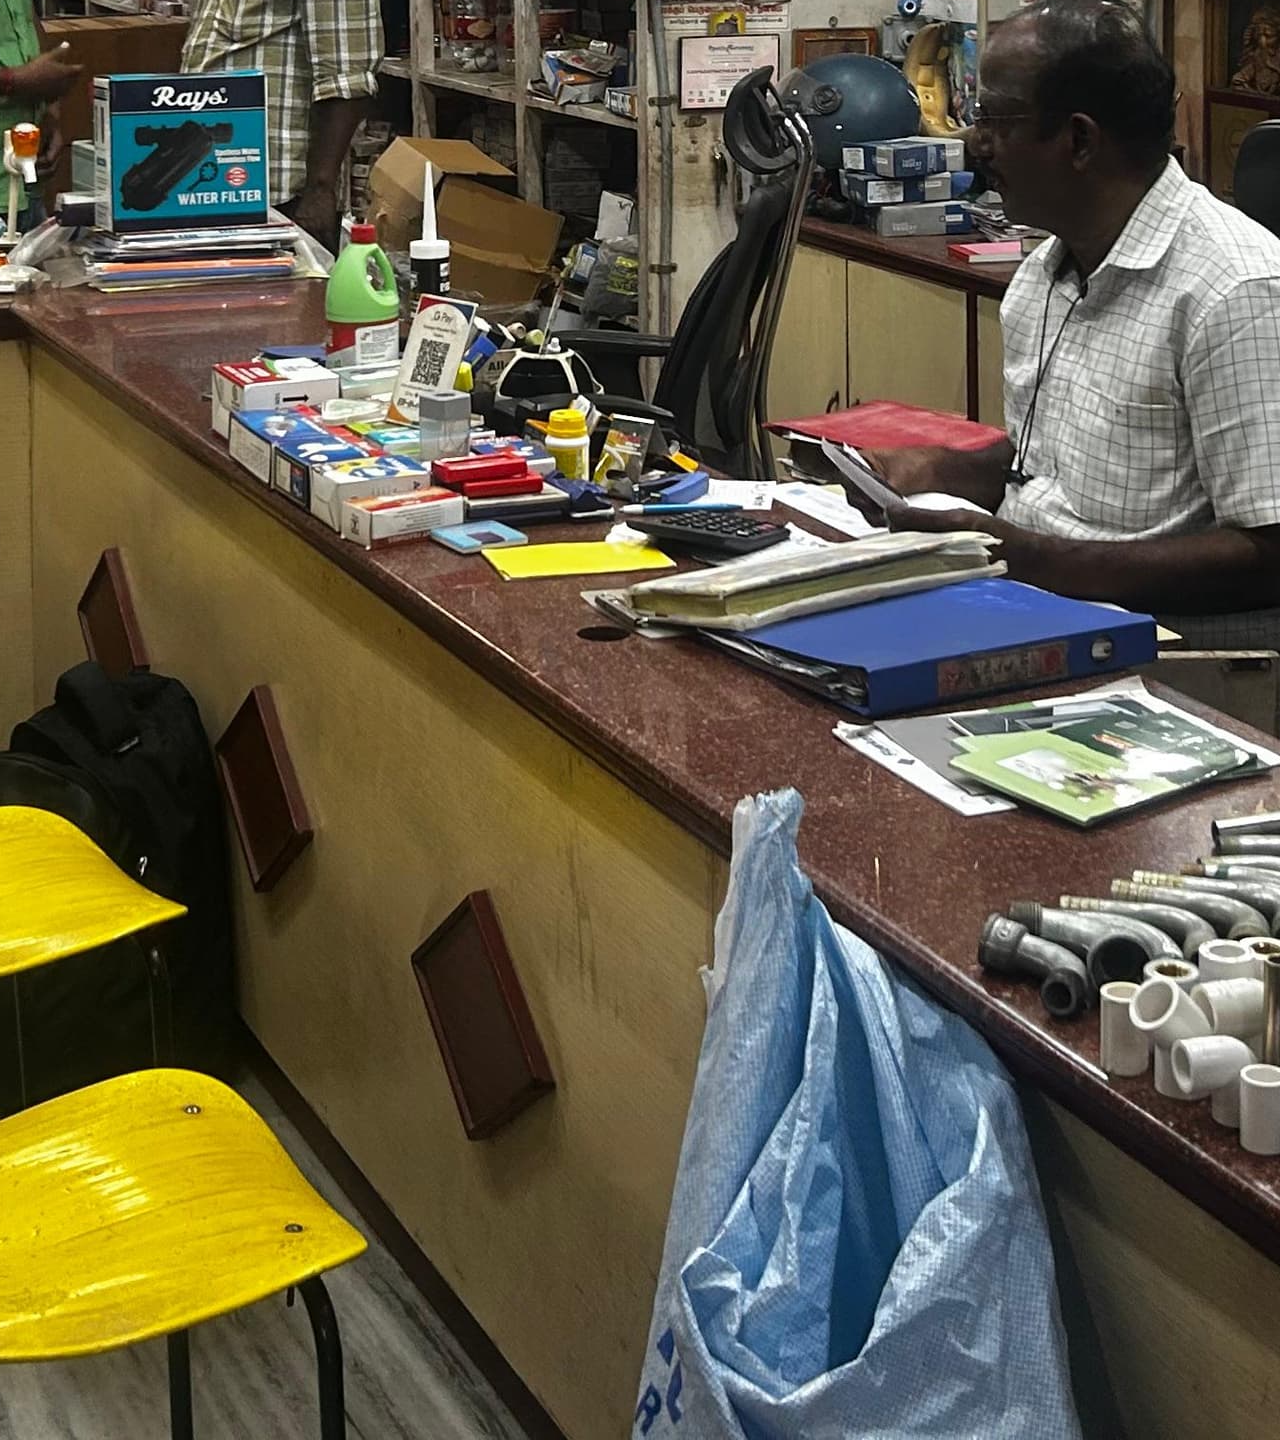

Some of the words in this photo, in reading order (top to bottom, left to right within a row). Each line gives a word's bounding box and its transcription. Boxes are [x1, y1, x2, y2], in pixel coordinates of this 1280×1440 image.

[151, 86, 228, 111] Rays
[178, 191, 219, 206] WATER
[221, 190, 262, 203] FILTER
